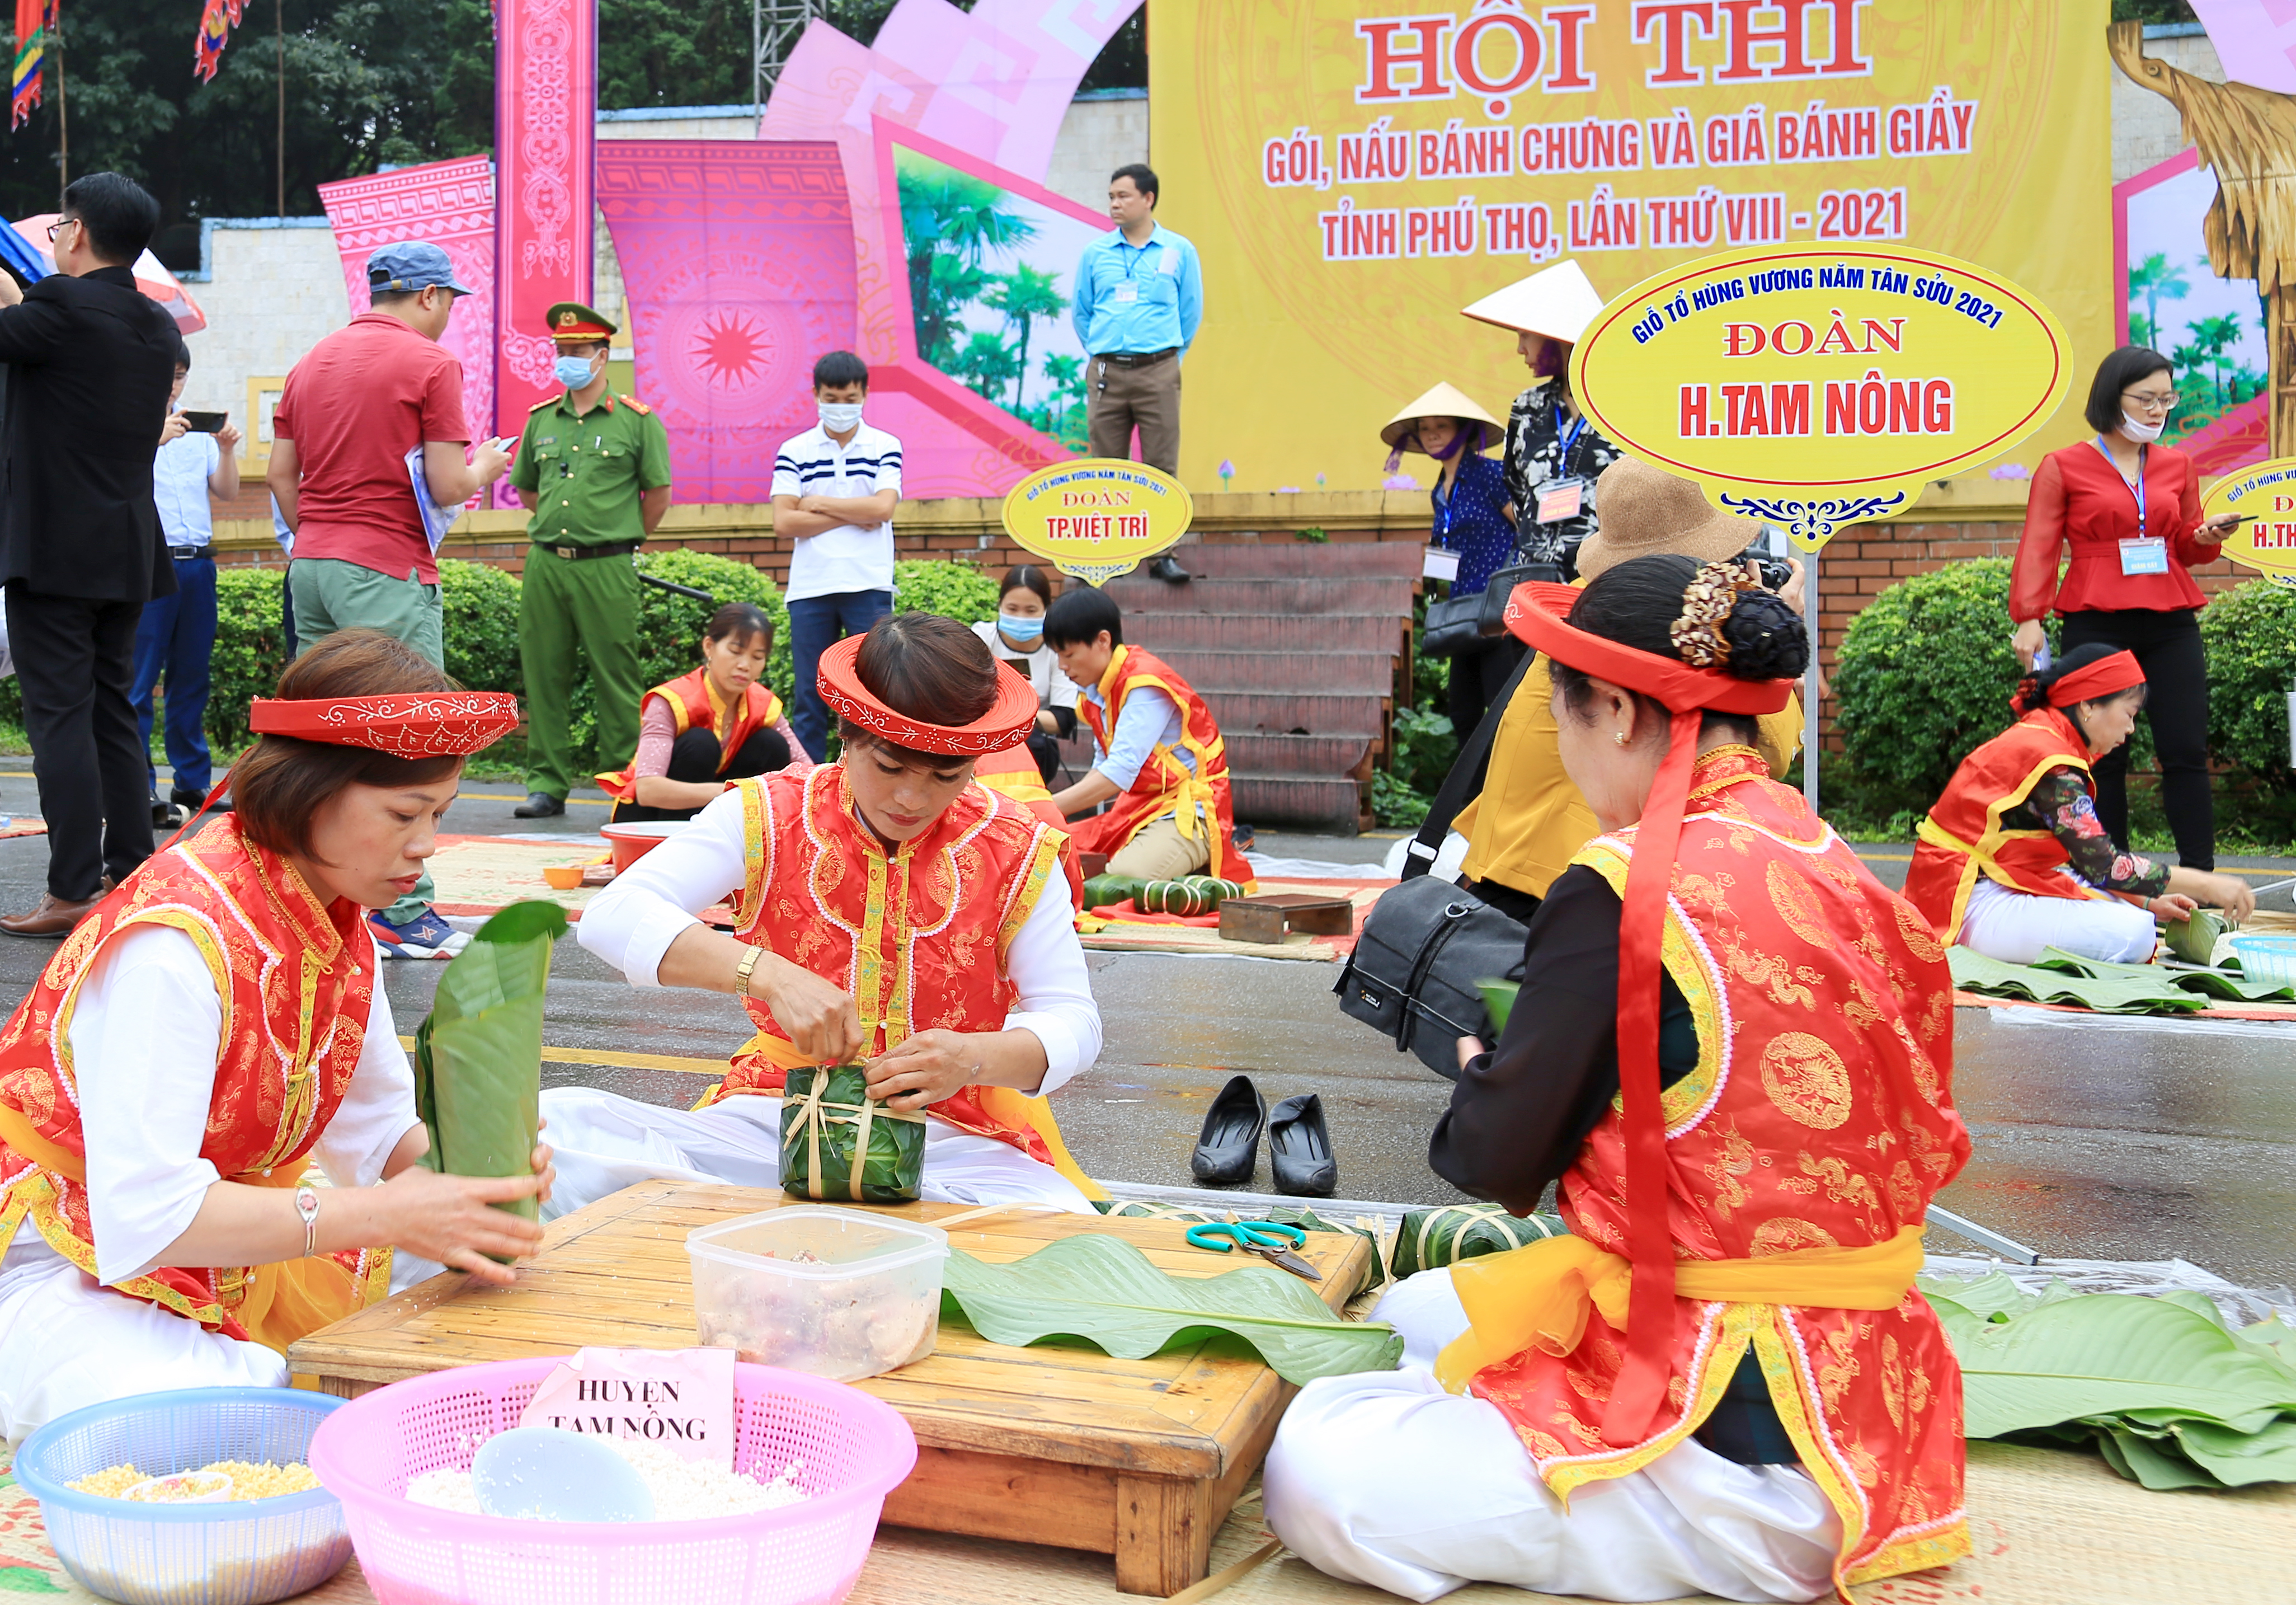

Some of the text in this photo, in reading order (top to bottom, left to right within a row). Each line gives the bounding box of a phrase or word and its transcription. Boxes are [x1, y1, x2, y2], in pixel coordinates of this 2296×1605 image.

[1361, 0, 1867, 114] HỘI THI
[1267, 91, 1973, 186] GÓI, NẤU BÁNH CHƯNG VÀ GIÃ BÁNH GIẦY
[1323, 199, 1396, 256] TỈNH
[1409, 200, 1474, 253] PHÚ
[1485, 207, 1558, 259] THỌ,
[1572, 187, 1635, 247] LẦN
[1649, 190, 1718, 244] THỨ
[1725, 197, 1781, 241] VIII
[1820, 191, 1902, 237] 2021
[1631, 263, 2003, 344] GIỖ TỔ HÙNG VƯƠNG NĂM TÂN SỬU 2021
[1724, 309, 1906, 357] ĐOÀN
[1681, 372, 1951, 437] H.TAM NÔNG
[1063, 487, 1131, 506] ĐOÀN
[1150, 482, 1167, 496] 2021
[1047, 511, 1148, 543] TP.VIỆT TRÌ
[577, 1377, 681, 1409] HUYỆN
[623, 1410, 706, 1441] NÔNG
